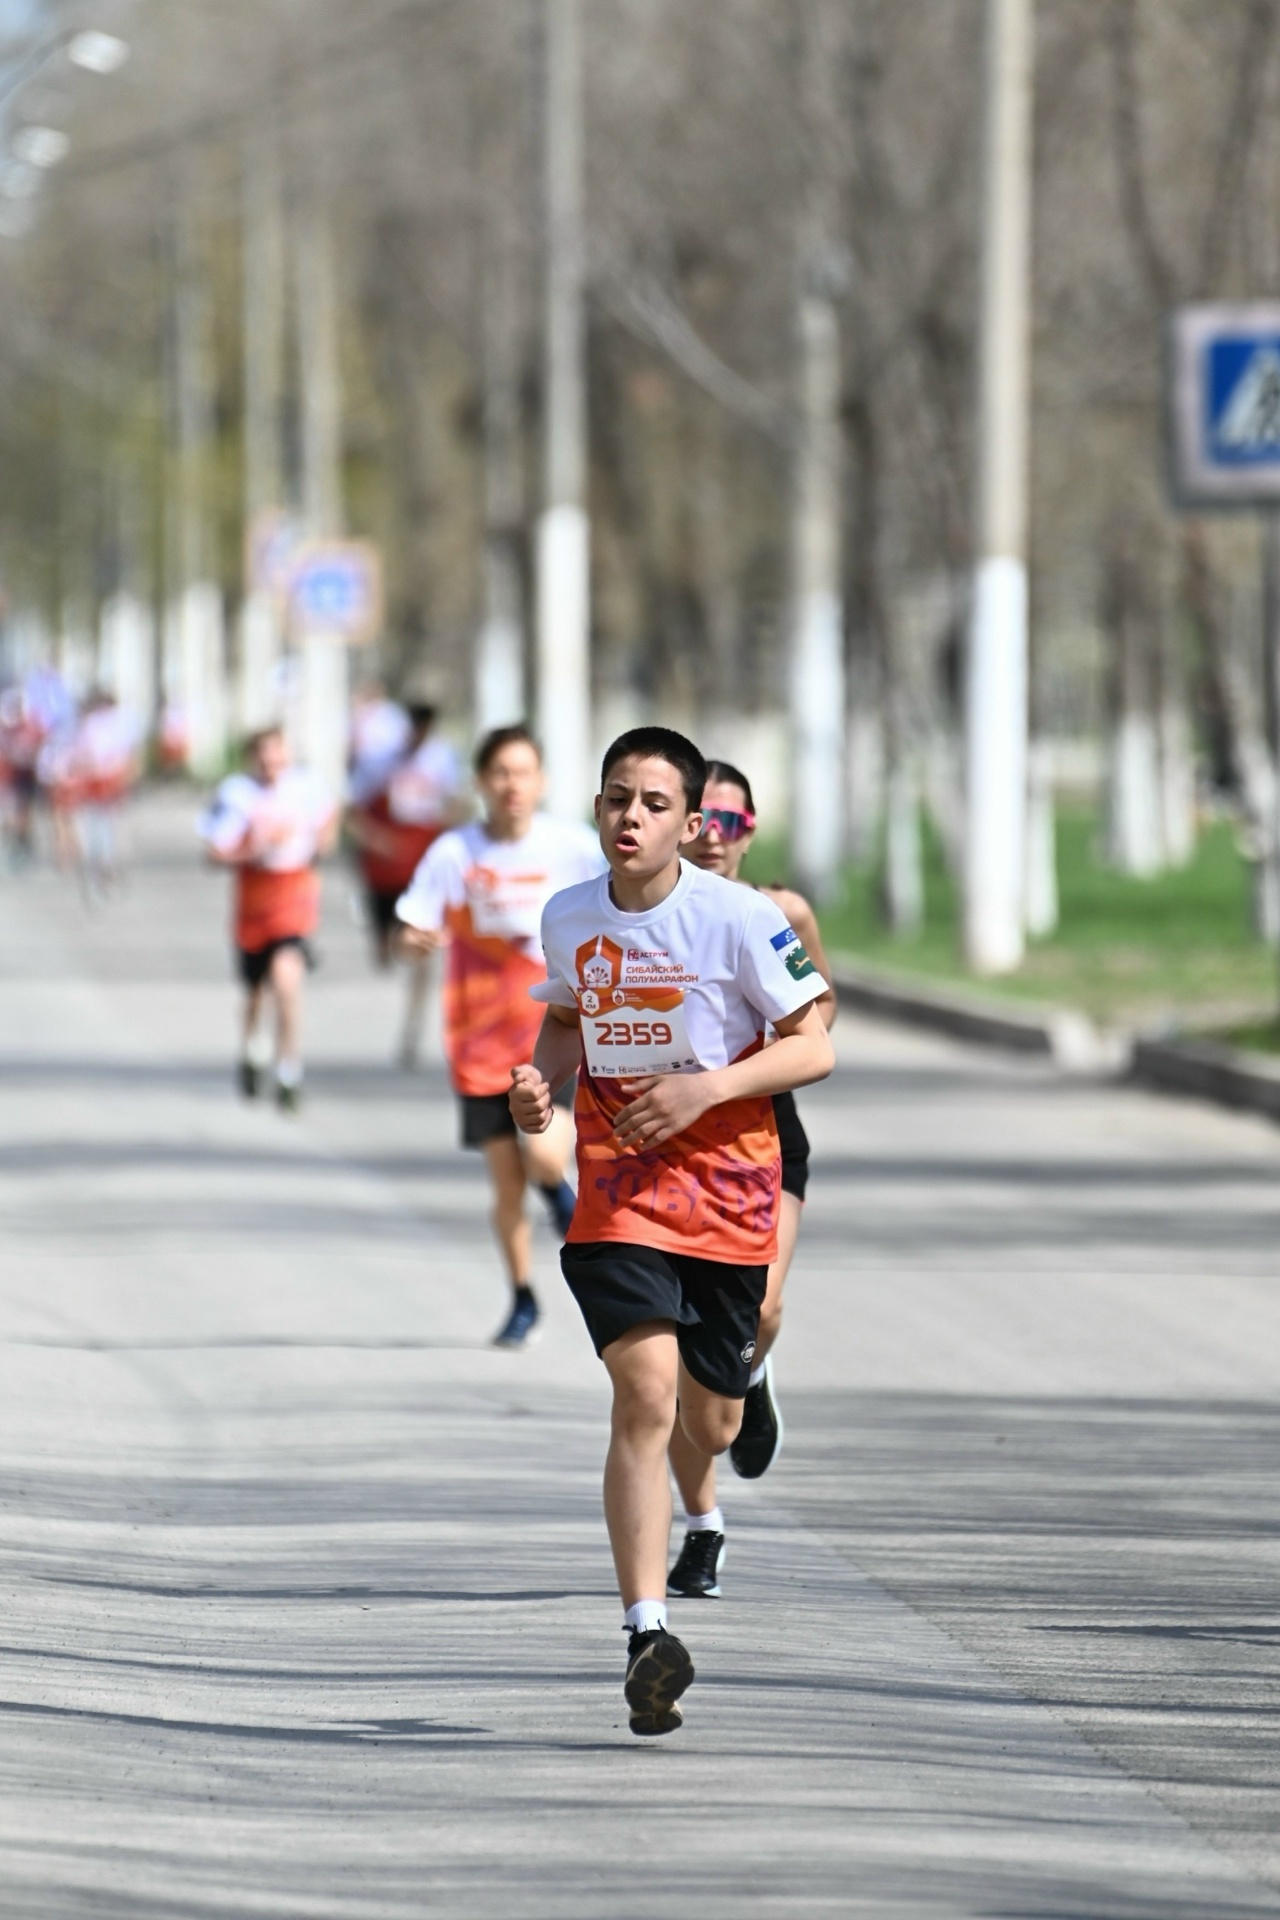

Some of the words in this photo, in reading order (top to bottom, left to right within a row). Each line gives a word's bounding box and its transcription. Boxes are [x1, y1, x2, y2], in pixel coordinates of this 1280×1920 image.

[626, 965, 683, 974] СИБАЙСКИЙ
[625, 975, 699, 984] ПОЛУМАРАФОН
[594, 1022, 672, 1046] 2359
